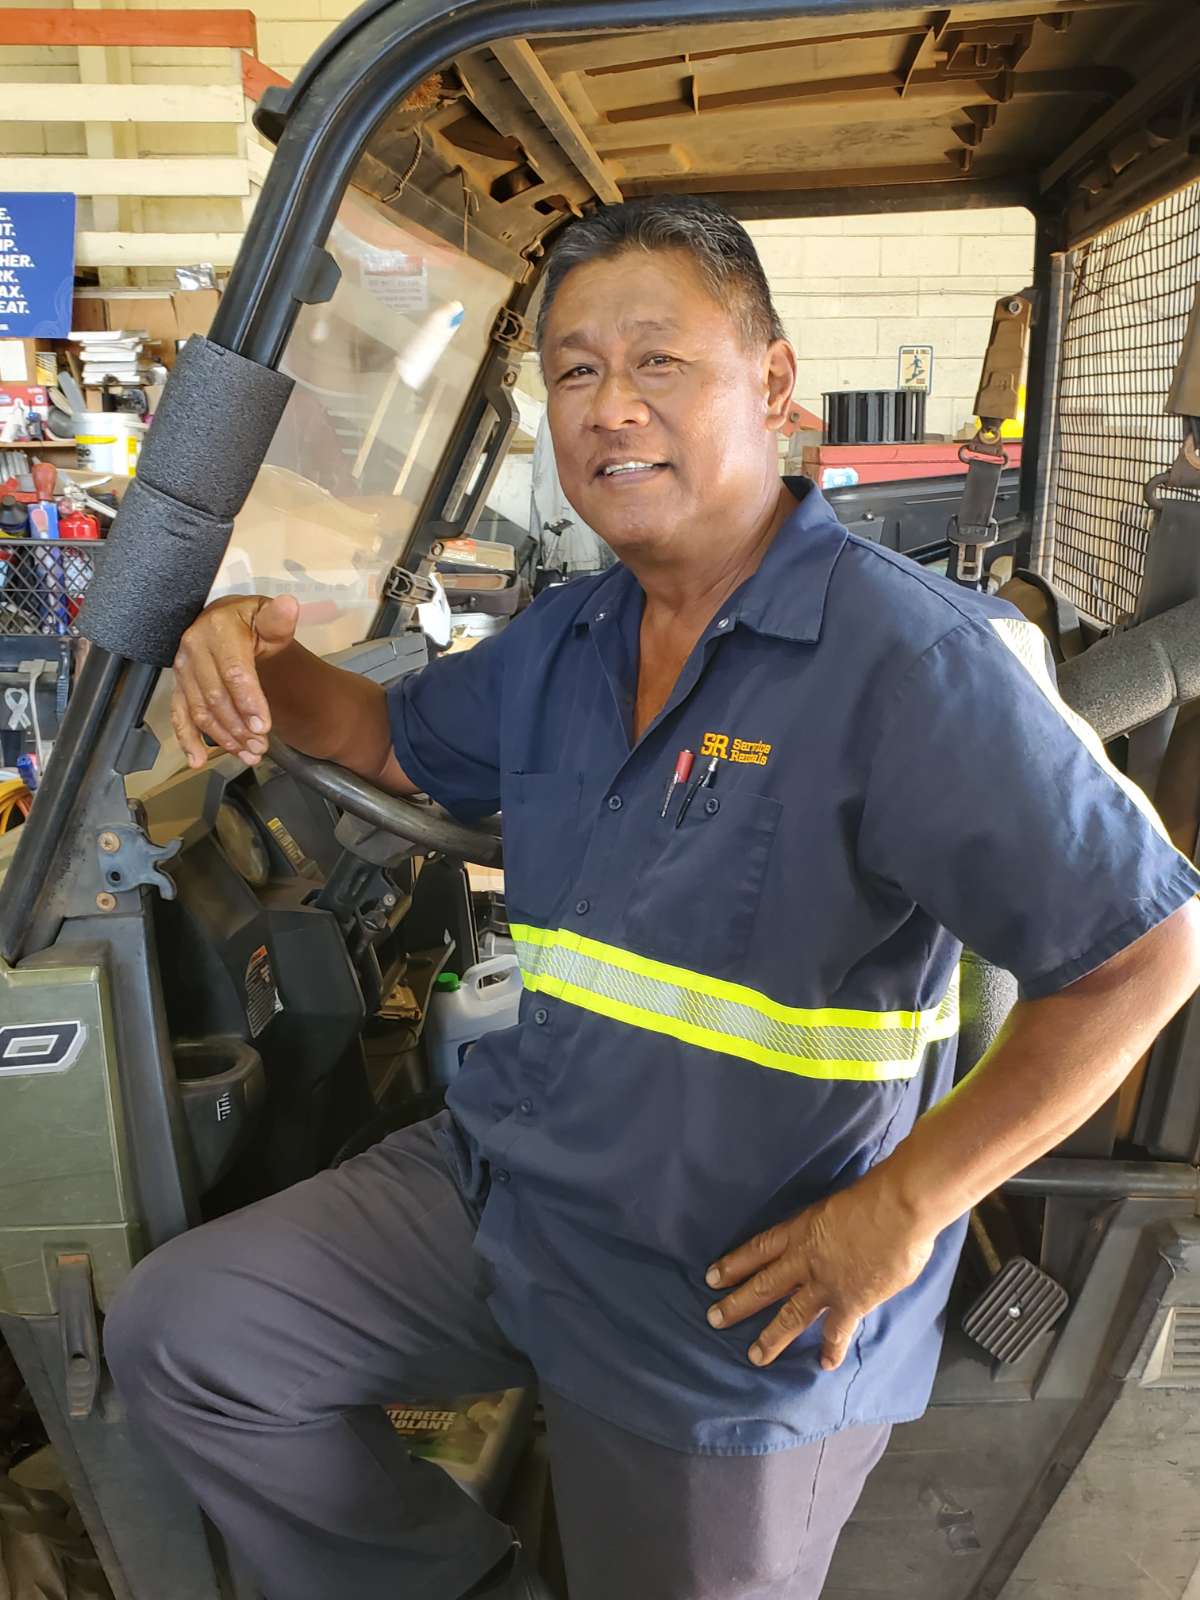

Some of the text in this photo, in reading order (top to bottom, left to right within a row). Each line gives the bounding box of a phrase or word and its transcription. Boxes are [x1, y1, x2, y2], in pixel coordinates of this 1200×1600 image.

[700, 732, 729, 759] SR
[732, 738, 772, 754] Service
[386, 1409, 457, 1421] TIFREEZE
[392, 1419, 453, 1431] OLANT
